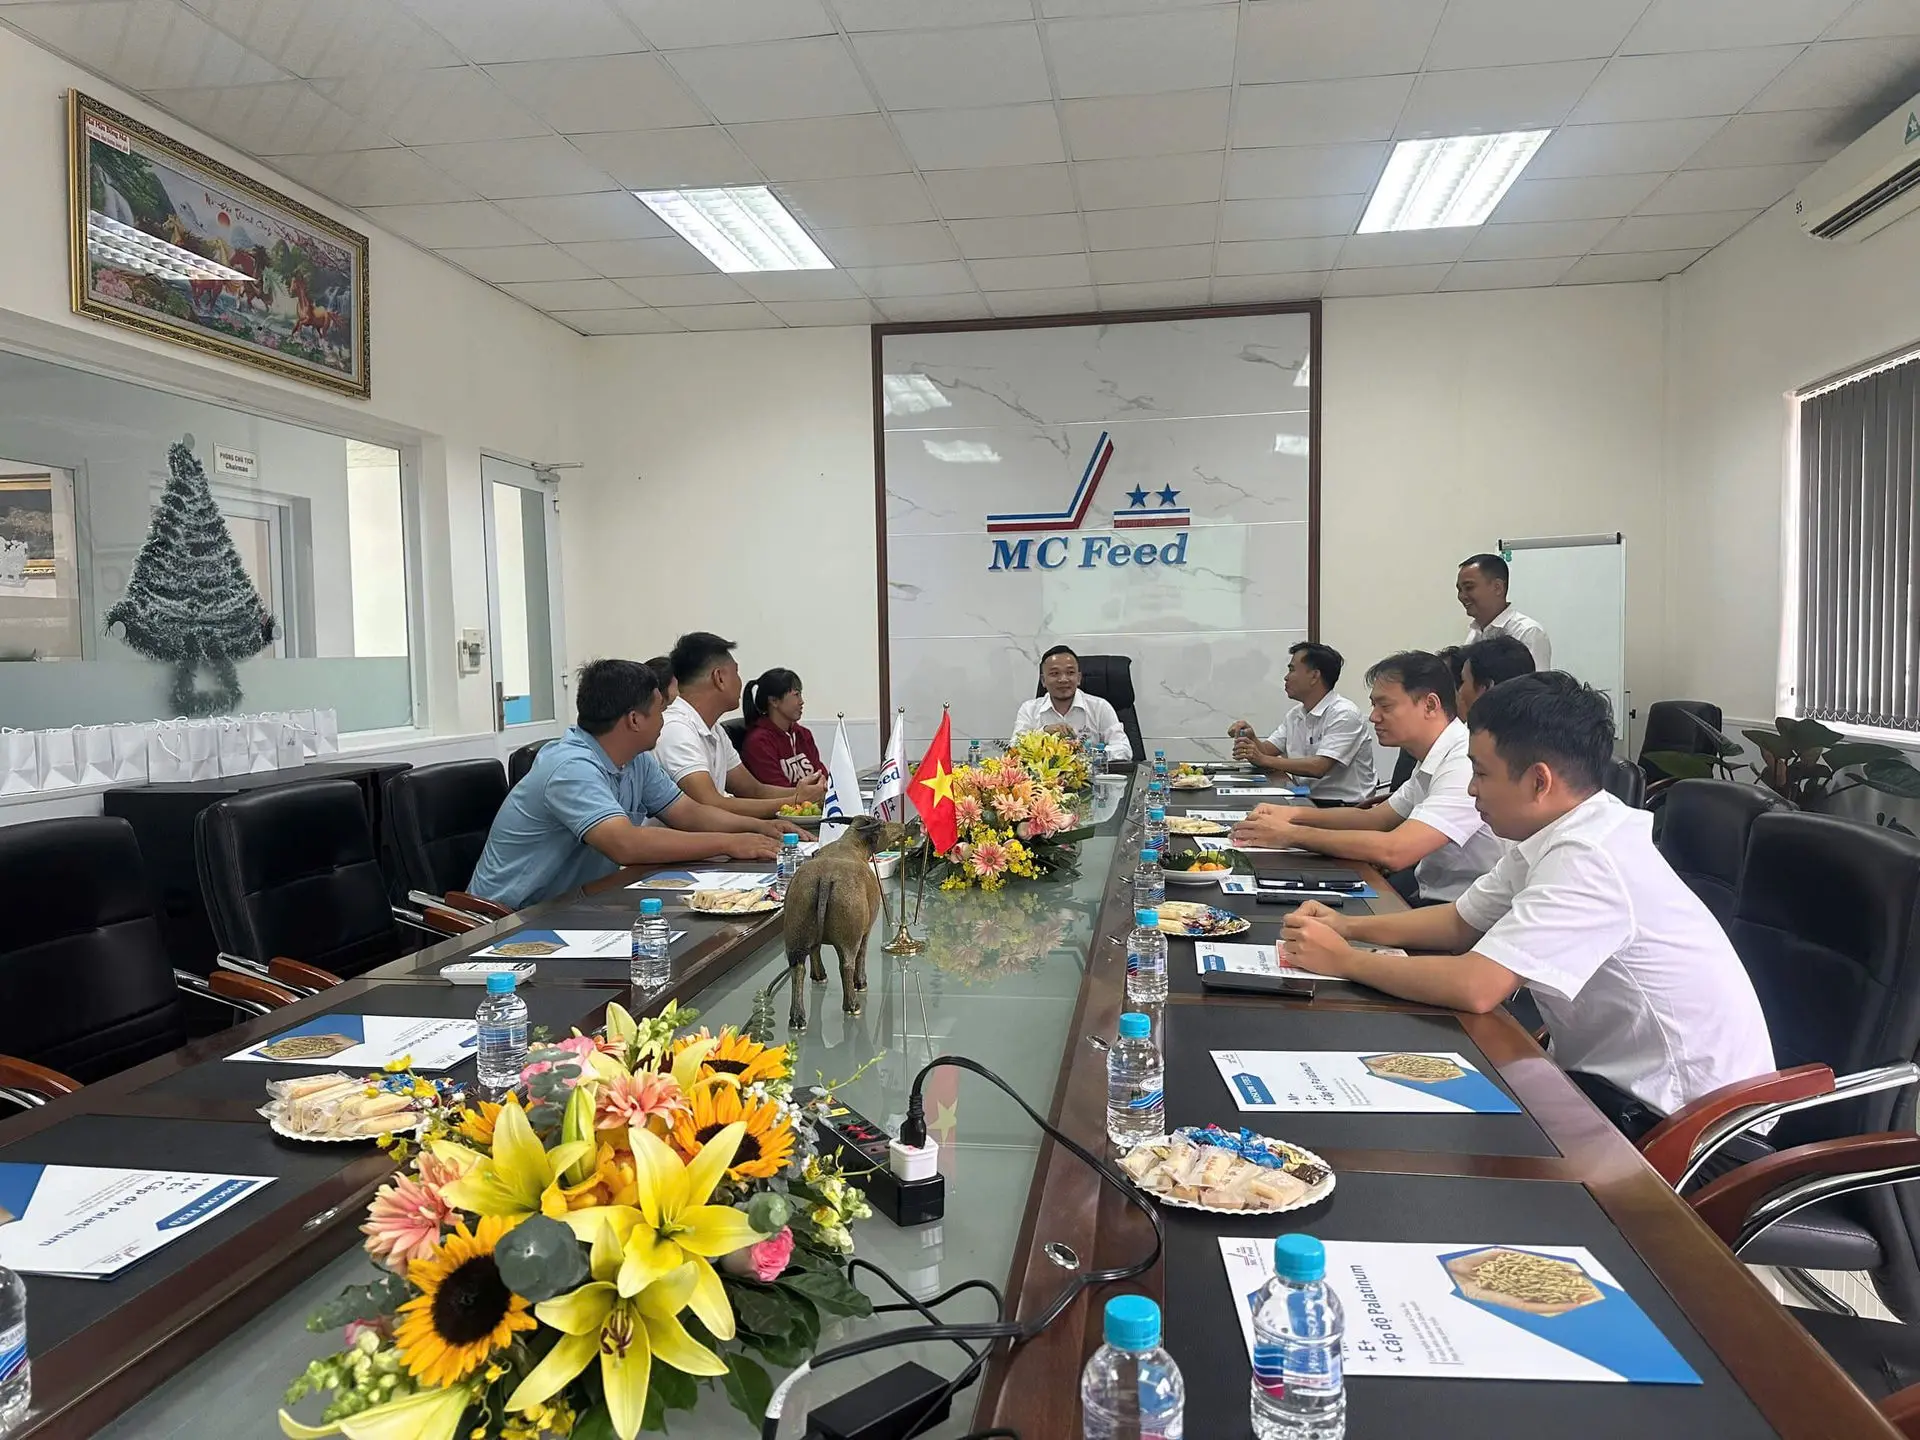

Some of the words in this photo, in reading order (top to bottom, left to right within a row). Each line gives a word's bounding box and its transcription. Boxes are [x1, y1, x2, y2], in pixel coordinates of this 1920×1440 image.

[225, 462, 248, 472] Chairman
[988, 536, 1069, 570] MC
[1077, 532, 1189, 567] Feed
[135, 1180, 165, 1196] Cấp
[166, 1182, 185, 1191] E+
[180, 1182, 203, 1194] M+
[115, 1195, 138, 1206] độ
[199, 1180, 249, 1210] MOSCOW
[168, 1208, 201, 1227] FEED
[38, 1206, 120, 1247] Palatinum
[1350, 1264, 1385, 1315] Palatinum
[1371, 1317, 1393, 1331] độ
[1358, 1340, 1377, 1352] E+
[1380, 1336, 1404, 1353] Cấp
